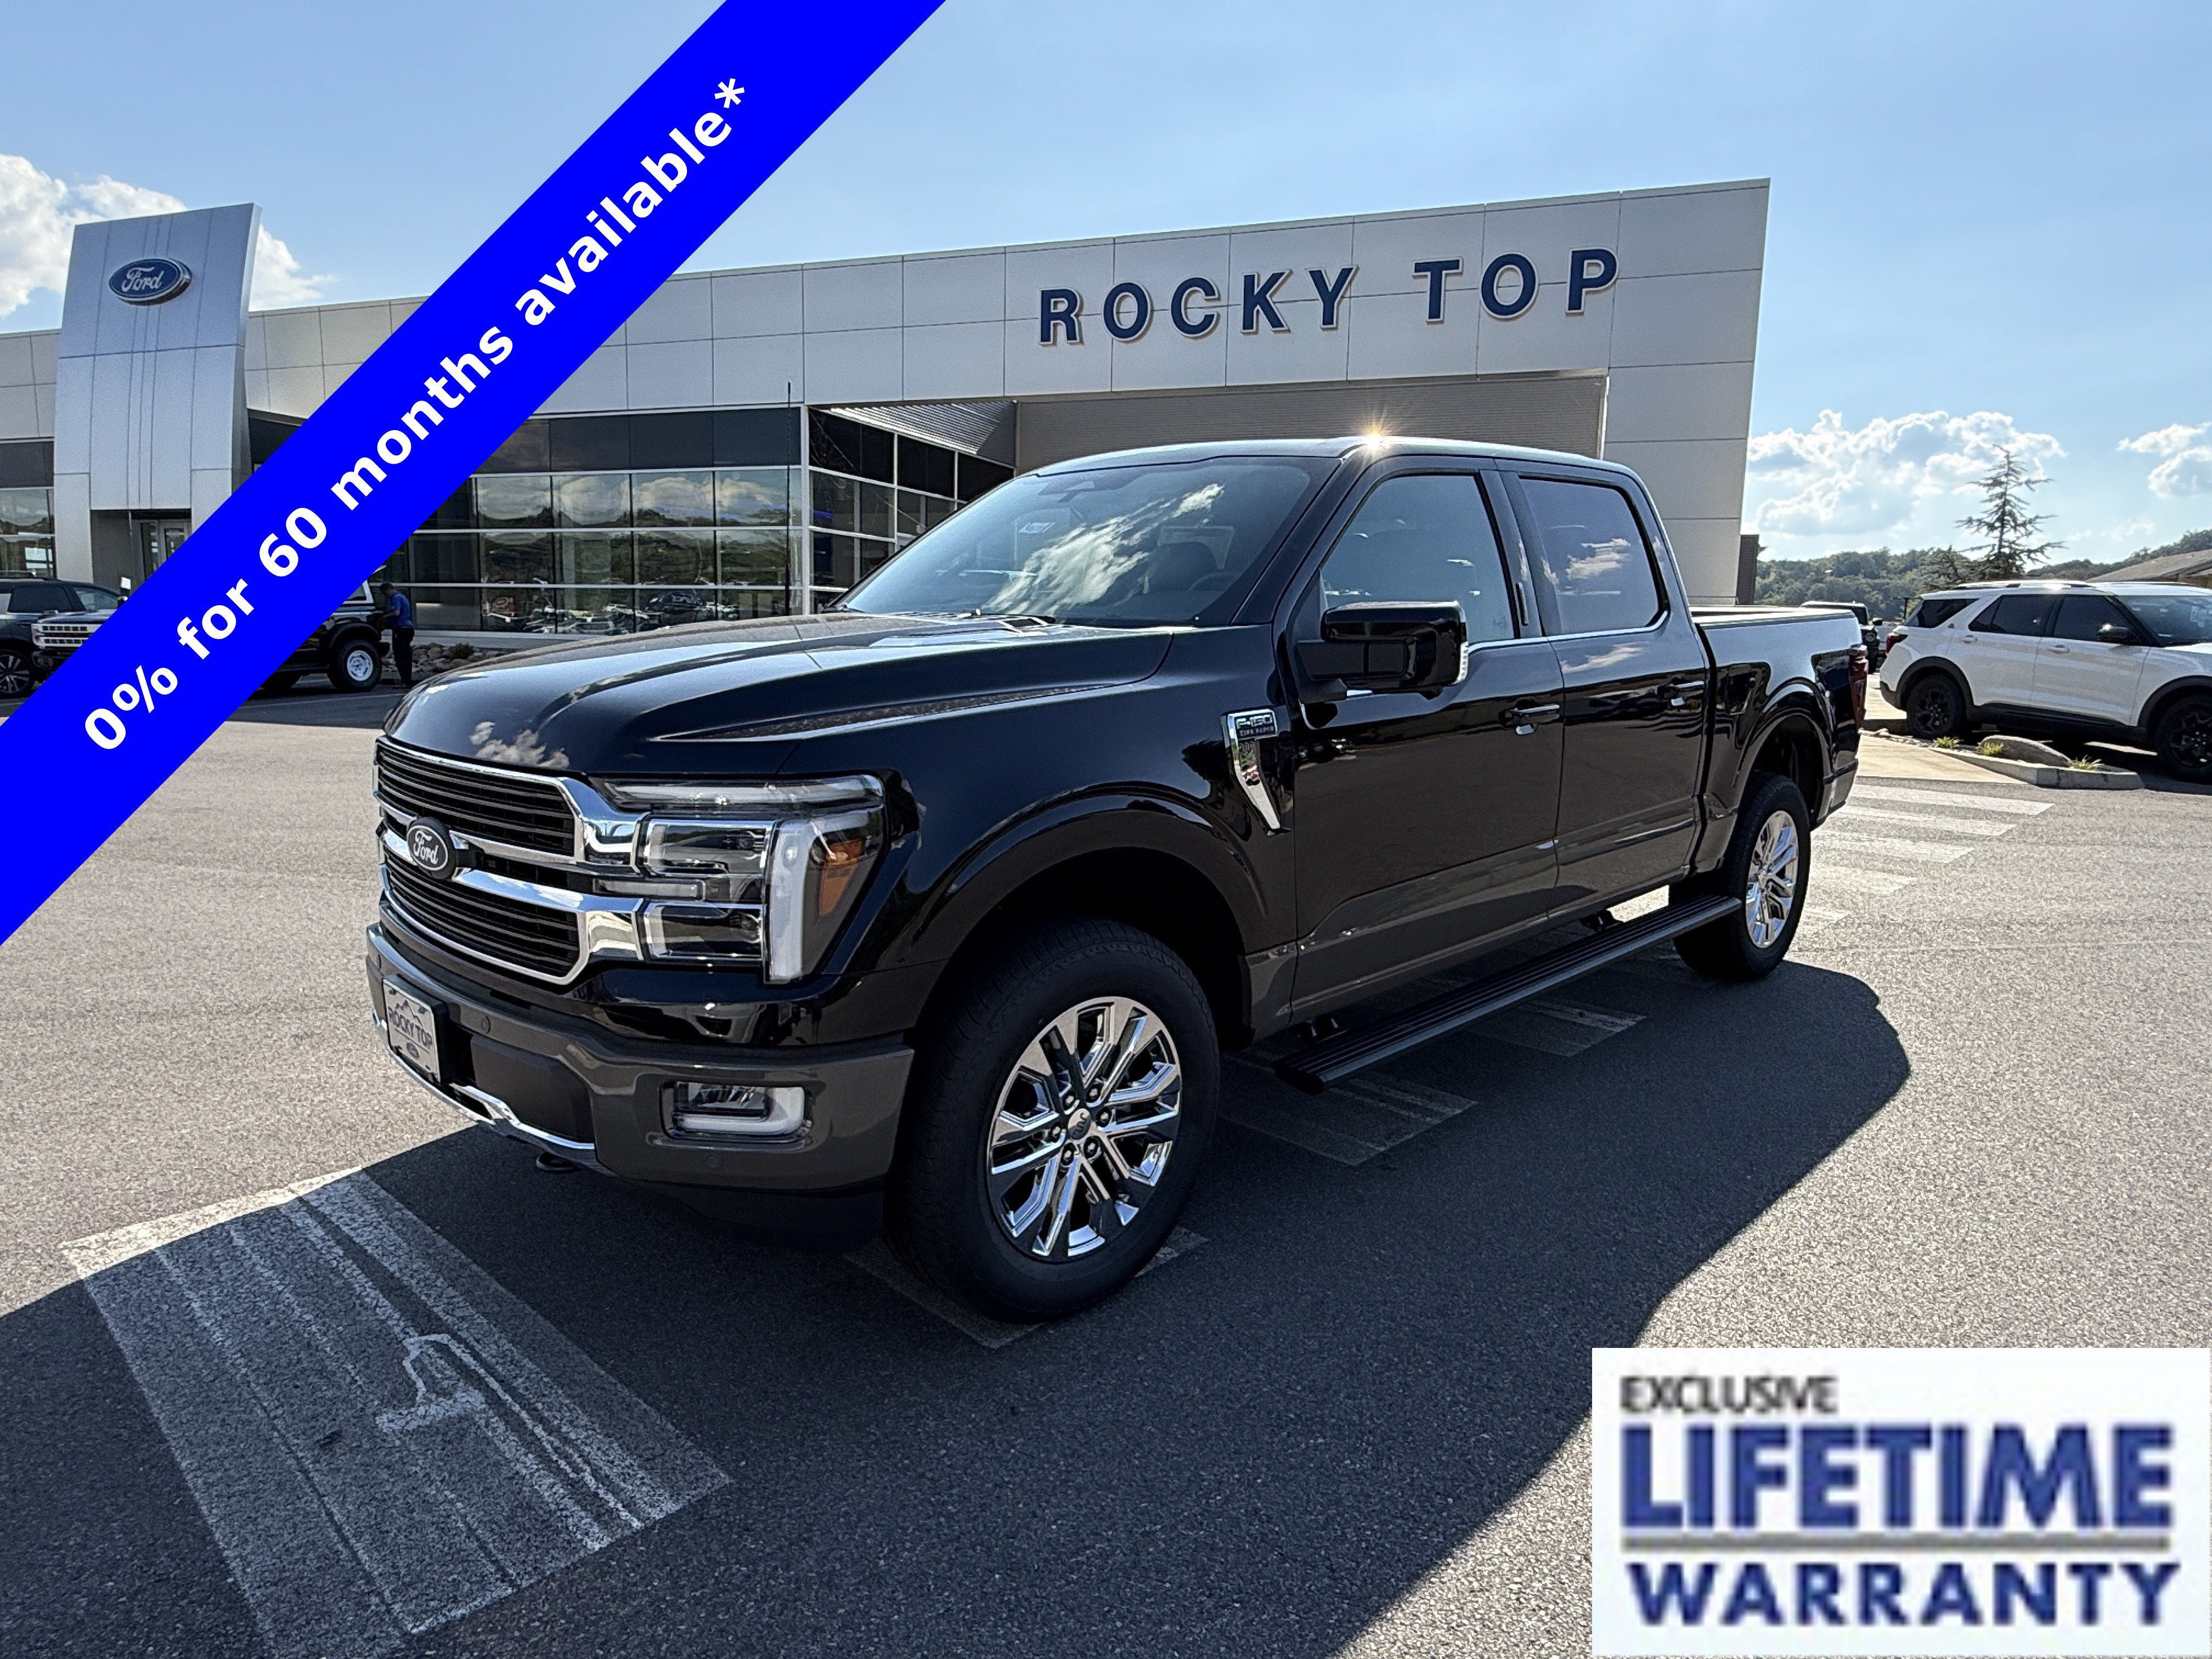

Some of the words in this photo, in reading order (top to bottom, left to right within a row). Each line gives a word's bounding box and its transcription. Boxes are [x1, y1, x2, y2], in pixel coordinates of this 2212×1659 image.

[121, 267, 165, 292] Ford
[1039, 265, 1357, 345] ROCKY
[1413, 246, 1620, 323] TOP
[1236, 714, 1273, 730] F-150
[413, 830, 439, 865] Ford
[415, 1024, 433, 1049] TOP
